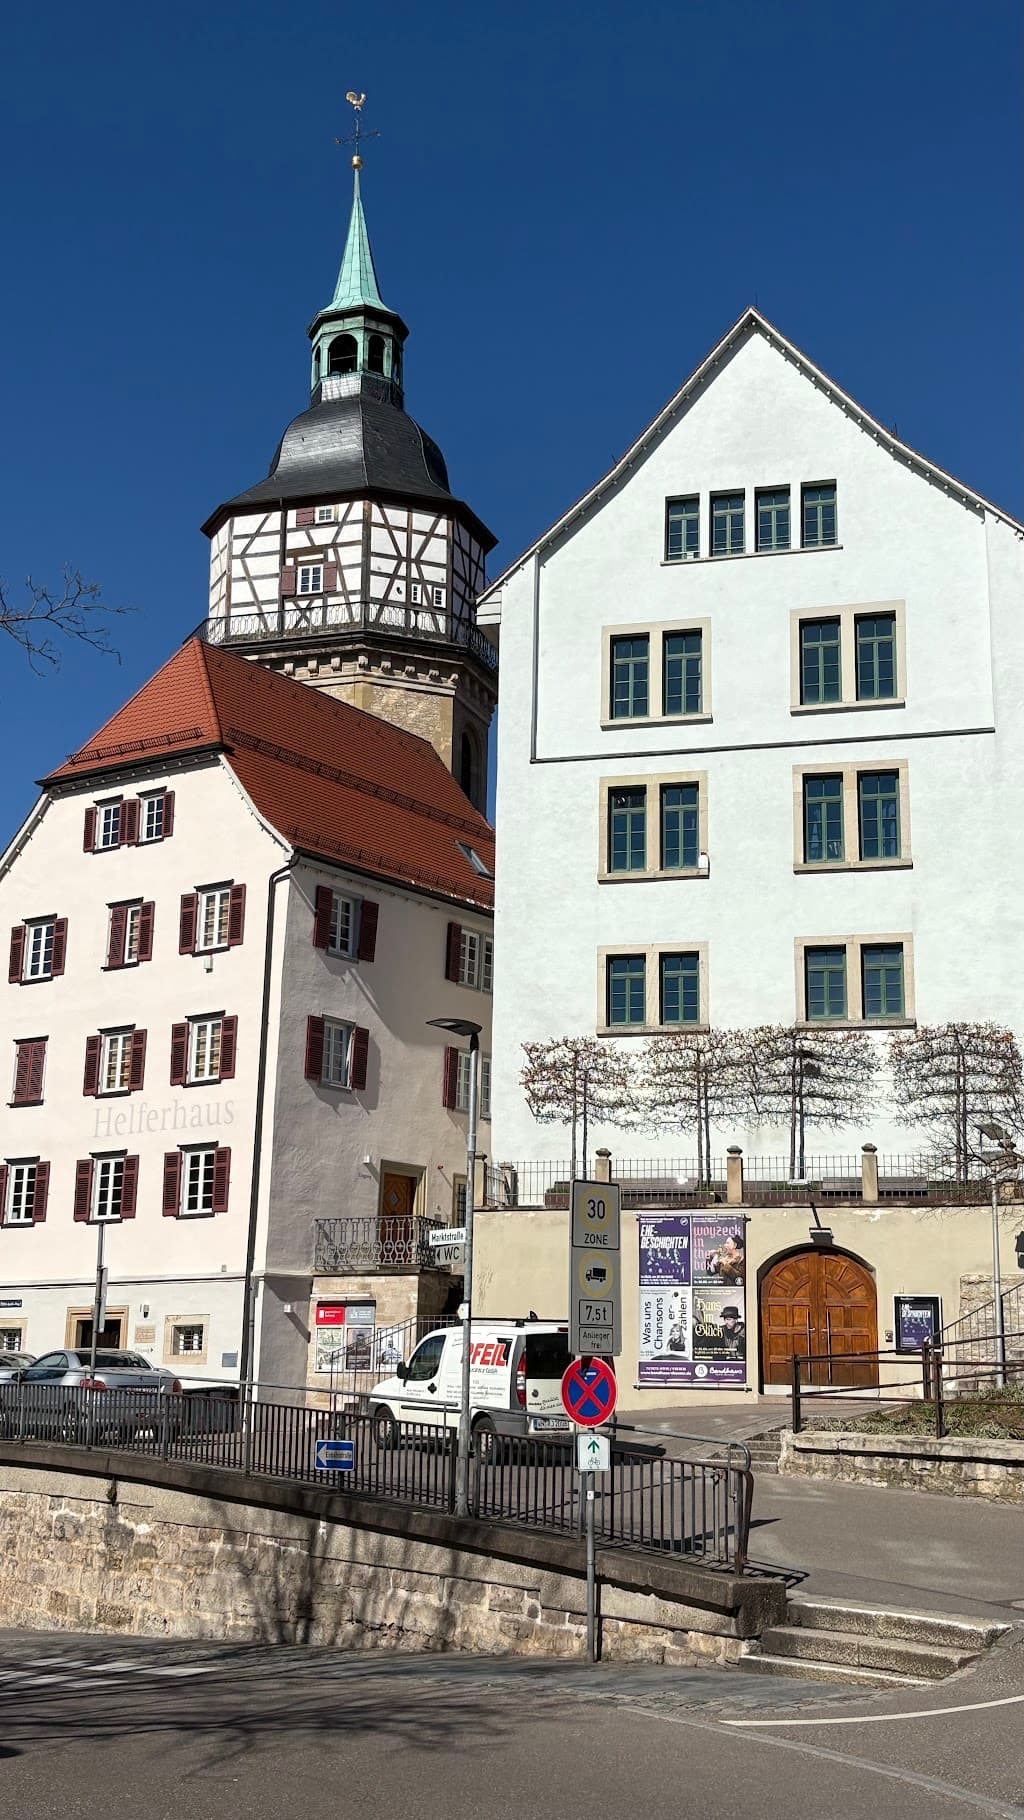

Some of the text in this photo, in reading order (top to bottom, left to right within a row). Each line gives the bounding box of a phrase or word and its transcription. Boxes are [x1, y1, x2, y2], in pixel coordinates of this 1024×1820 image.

[93, 1099, 234, 1137] Helferhaus
[587, 1199, 605, 1219] 30
[431, 1231, 464, 1243] Marktstraße
[640, 1224, 658, 1237] EHE-
[693, 1224, 741, 1238] woyzeck
[584, 1233, 608, 1245] ZONE
[640, 1236, 689, 1249] GESCHICHTEN
[693, 1237, 705, 1248] in
[444, 1246, 460, 1260] WC
[693, 1247, 711, 1259] the
[693, 1259, 714, 1271] box
[694, 1296, 721, 1311] Hans
[644, 1301, 652, 1320] uns
[703, 1311, 714, 1323] im
[654, 1297, 664, 1350] Chansons
[582, 1331, 610, 1342] Anlieger
[642, 1322, 652, 1345] Was
[695, 1323, 724, 1339] Glück
[590, 1341, 602, 1349] fre
[709, 1366, 743, 1374] Bandhaus
